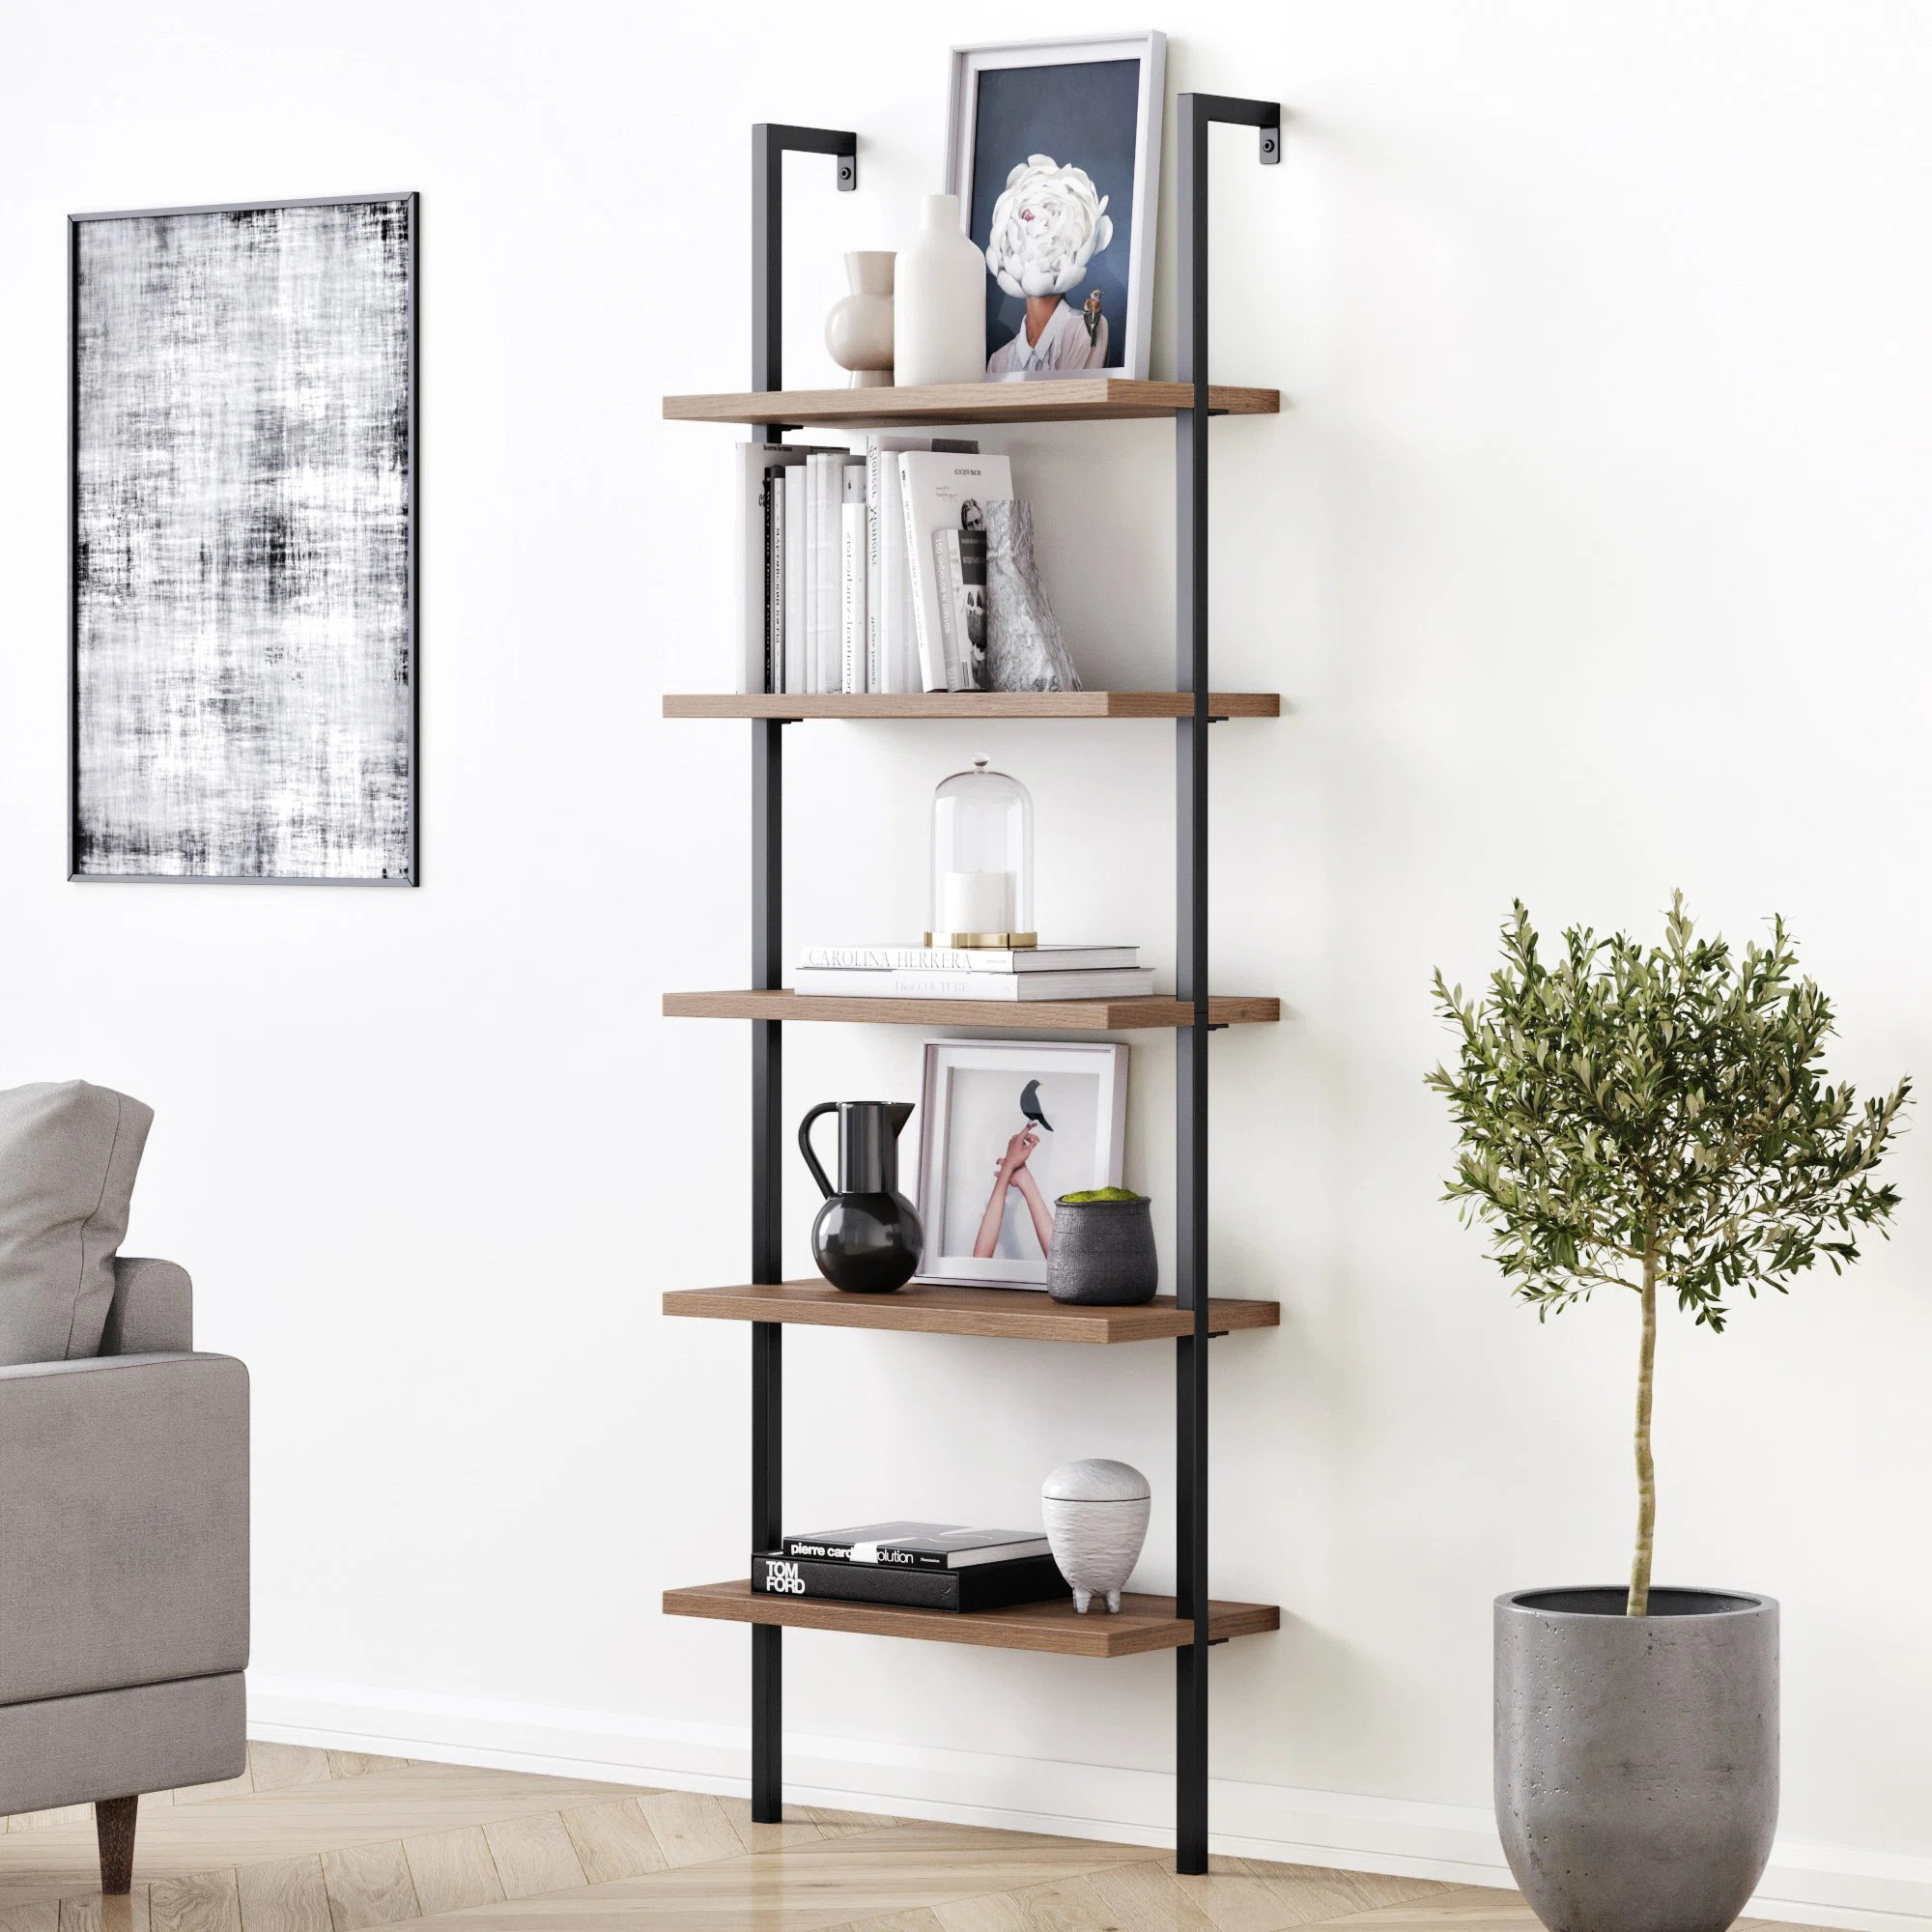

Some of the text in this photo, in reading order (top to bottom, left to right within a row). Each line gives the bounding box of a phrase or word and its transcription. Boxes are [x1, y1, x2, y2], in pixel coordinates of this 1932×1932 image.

[809, 951, 972, 969] CAROLINA HERRERA
[790, 1543, 825, 1557] pierre
[827, 1548, 854, 1559] card
[877, 1550, 914, 1564] olution
[766, 1561, 799, 1577] TOM
[766, 1577, 806, 1594] FORD
